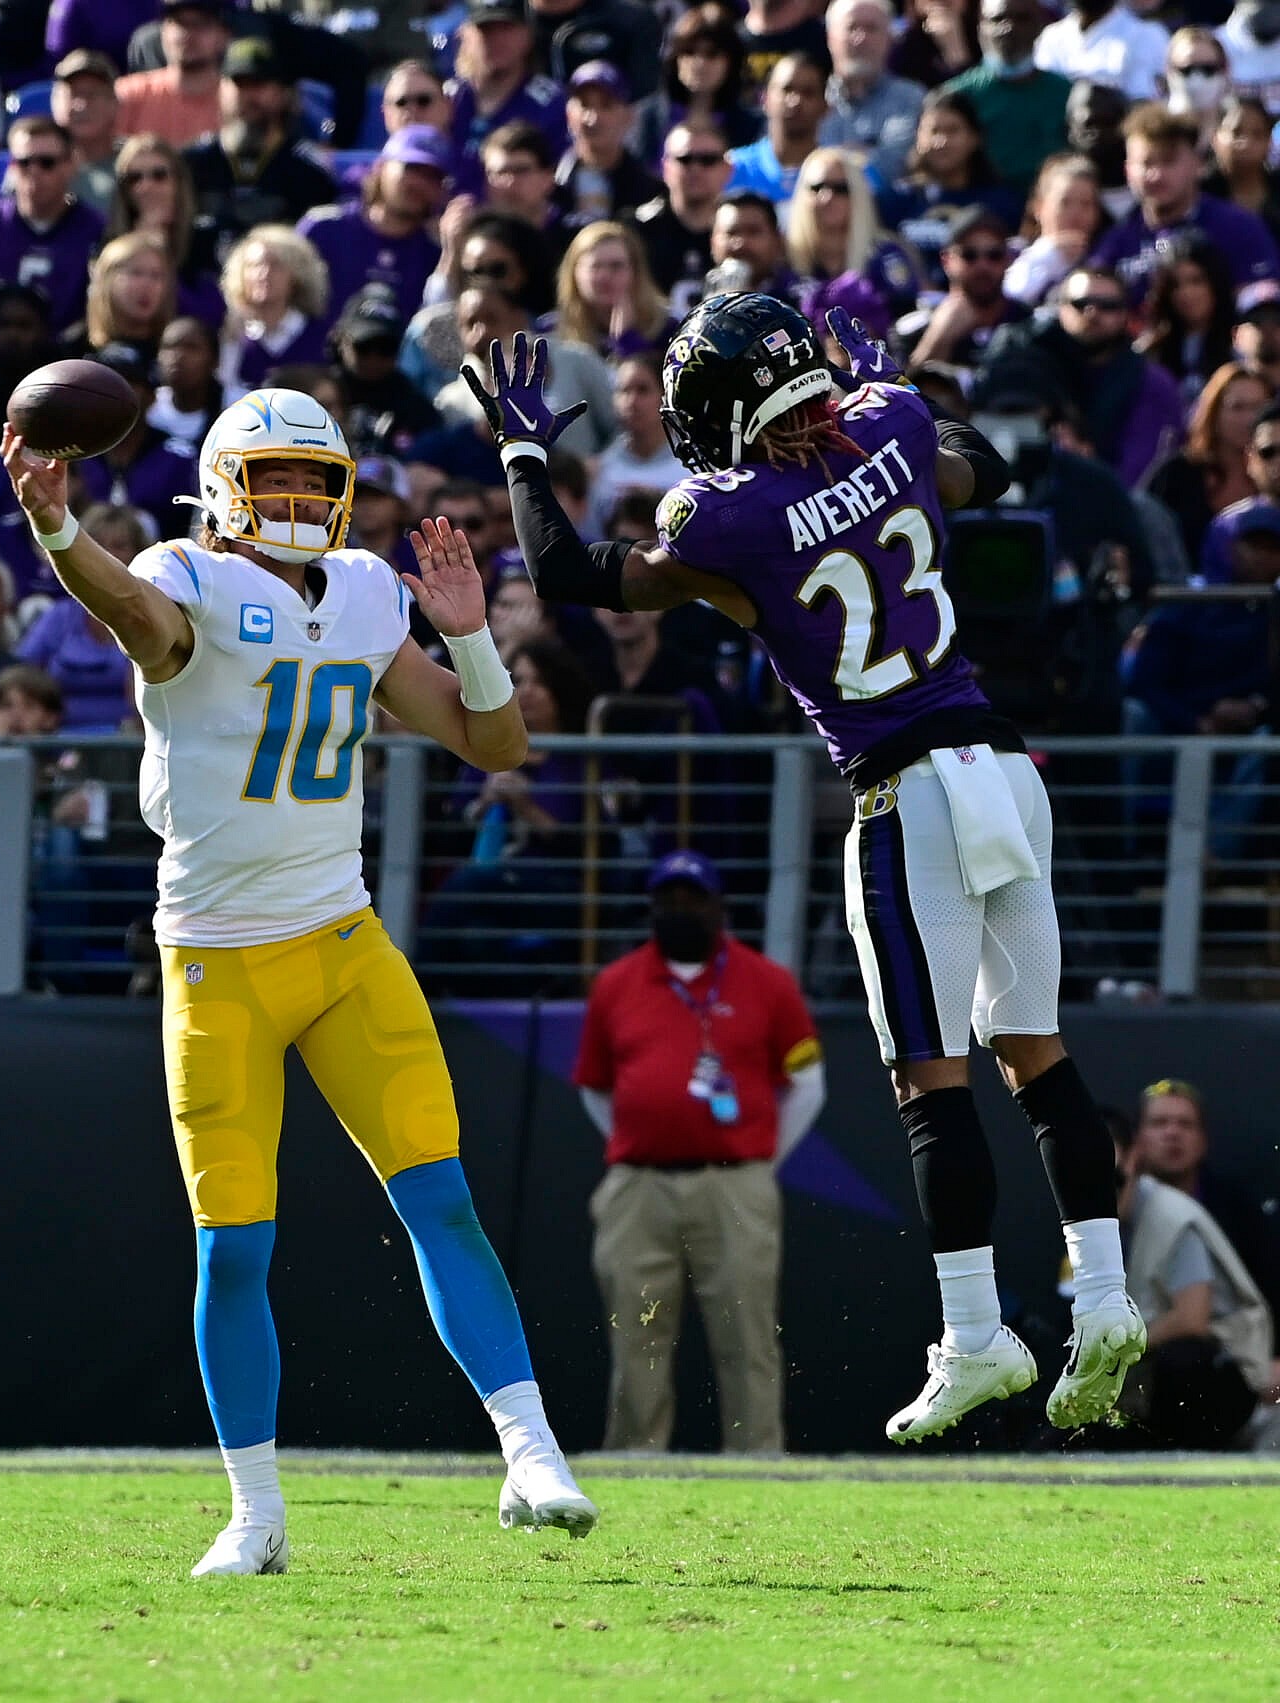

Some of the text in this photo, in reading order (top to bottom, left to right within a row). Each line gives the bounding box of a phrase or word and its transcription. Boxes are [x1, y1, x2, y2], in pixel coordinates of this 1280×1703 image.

[783, 338, 814, 367] 23
[787, 372, 826, 393] RAVENS
[786, 438, 914, 552] AVERETT
[243, 603, 272, 633] C
[793, 504, 957, 703] 23
[239, 658, 375, 804] 10
[860, 772, 901, 820] B
